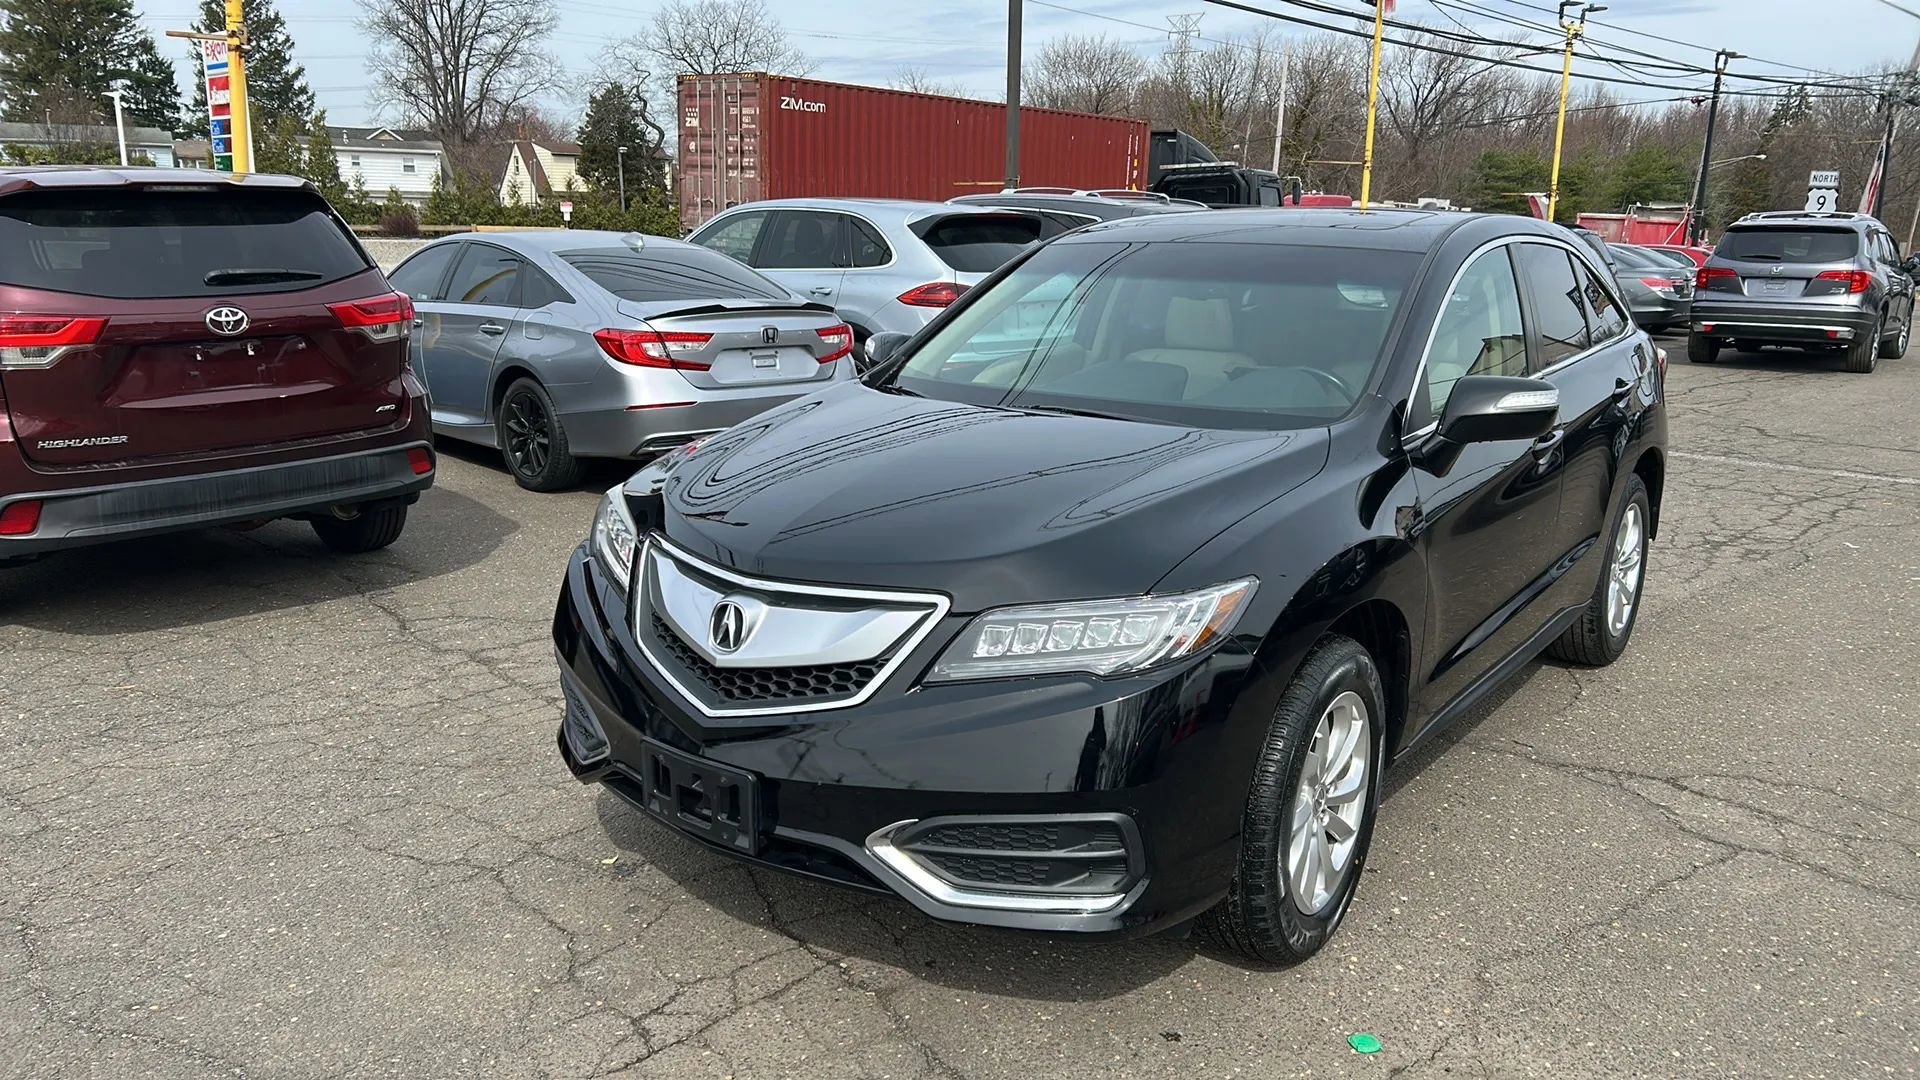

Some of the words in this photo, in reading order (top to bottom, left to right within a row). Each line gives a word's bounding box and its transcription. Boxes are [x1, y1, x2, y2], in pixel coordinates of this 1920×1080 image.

[205, 41, 227, 61] Exxon
[1812, 174, 1839, 183] NORTH
[1816, 195, 1826, 211] 9
[36, 434, 129, 450] HIGHLANDER
